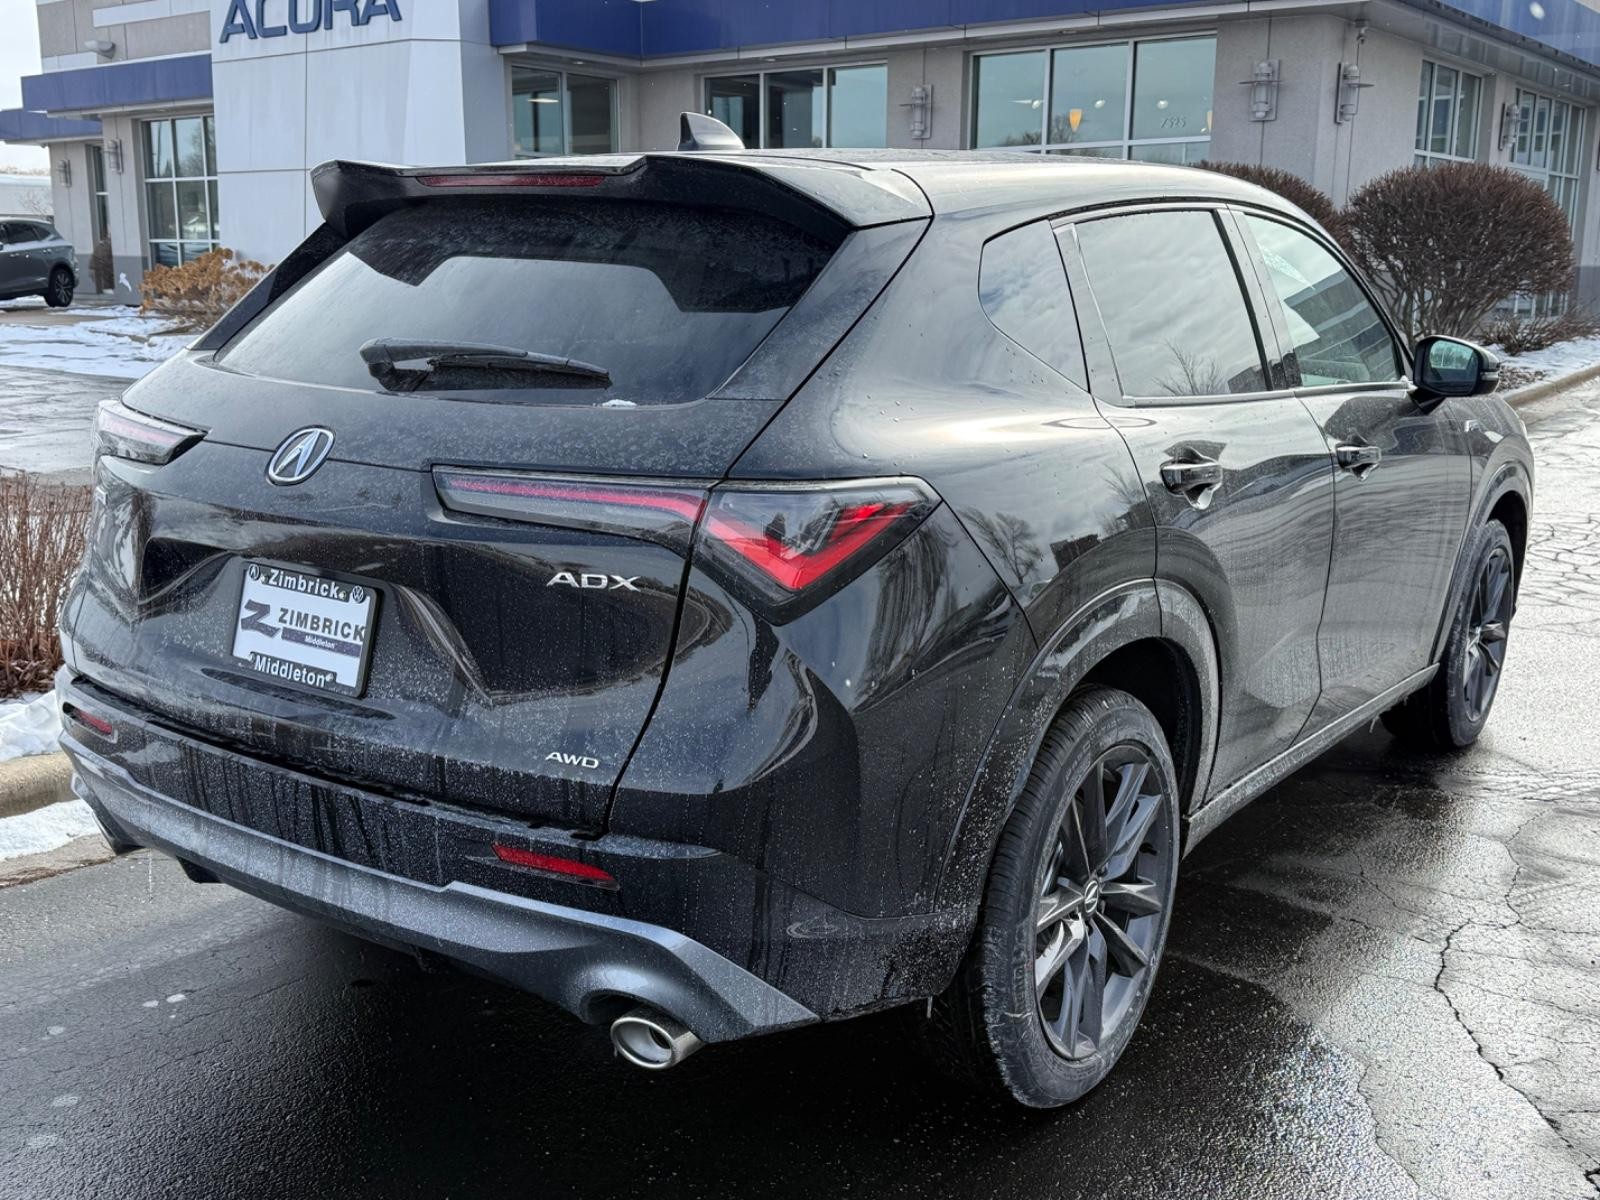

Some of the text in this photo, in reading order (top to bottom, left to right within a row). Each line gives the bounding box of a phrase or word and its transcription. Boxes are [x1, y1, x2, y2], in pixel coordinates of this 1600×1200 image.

[268, 569, 340, 598] Zimbrick
[546, 572, 641, 592] ADX
[278, 607, 366, 642] ZIMBRICK
[304, 635, 335, 649] Middleton
[254, 654, 326, 688] Middleton
[545, 752, 599, 769] AWD
